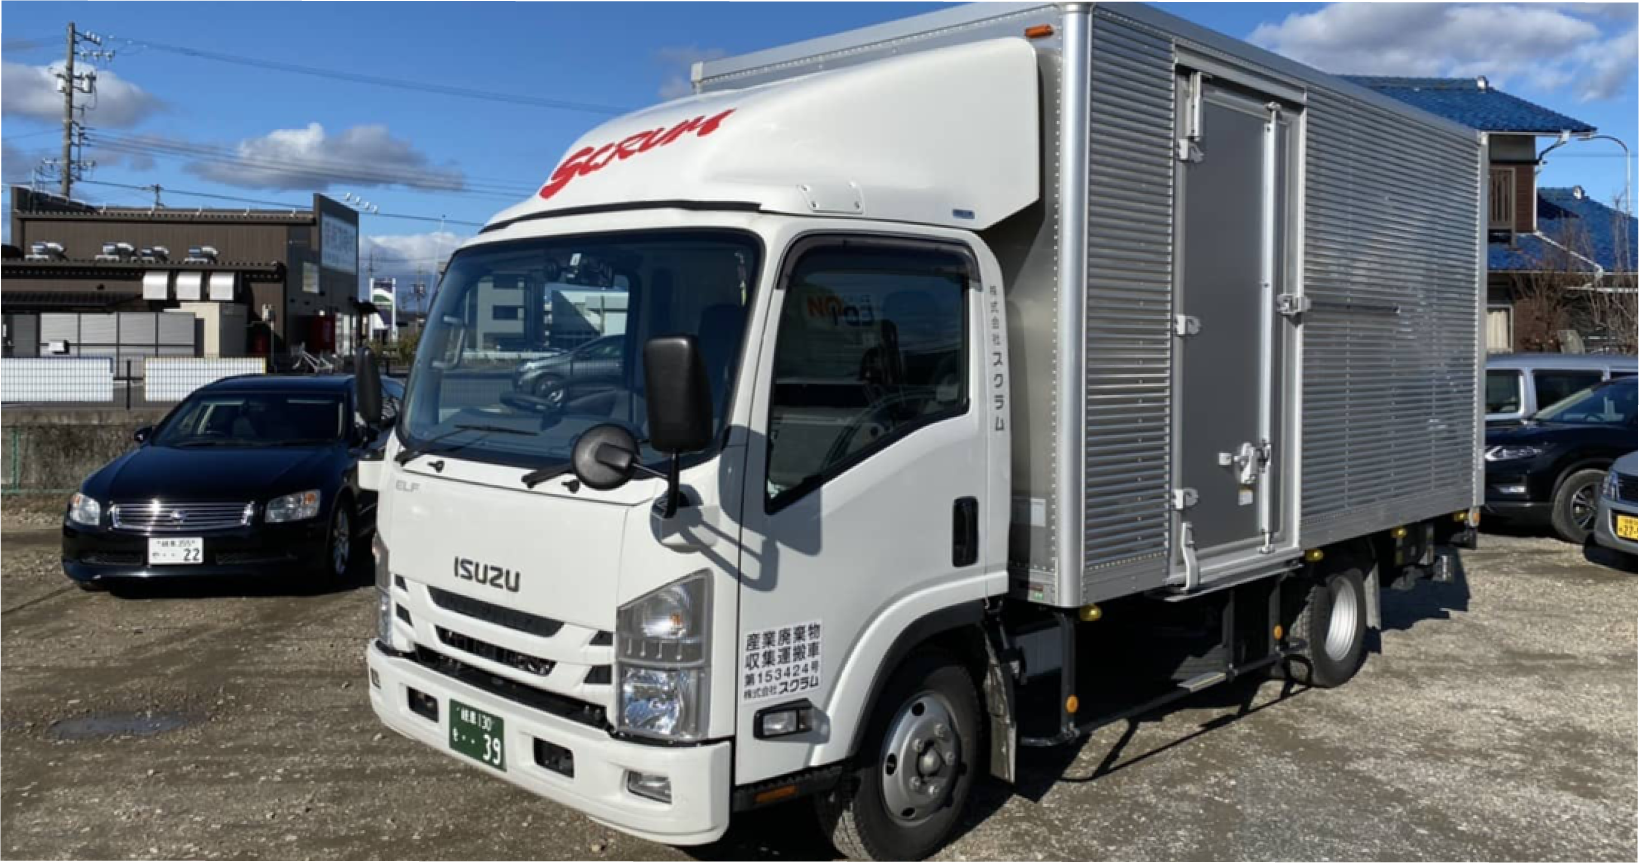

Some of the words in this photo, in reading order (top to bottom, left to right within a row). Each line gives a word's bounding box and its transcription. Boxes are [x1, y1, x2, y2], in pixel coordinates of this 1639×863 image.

[395, 480, 420, 492] ELF
[454, 556, 520, 593] ISUZU
[746, 622, 821, 652] 産業廃棄物
[744, 641, 820, 671] 収集運搬車
[744, 660, 819, 686] 第153424号
[482, 733, 501, 766] 39
